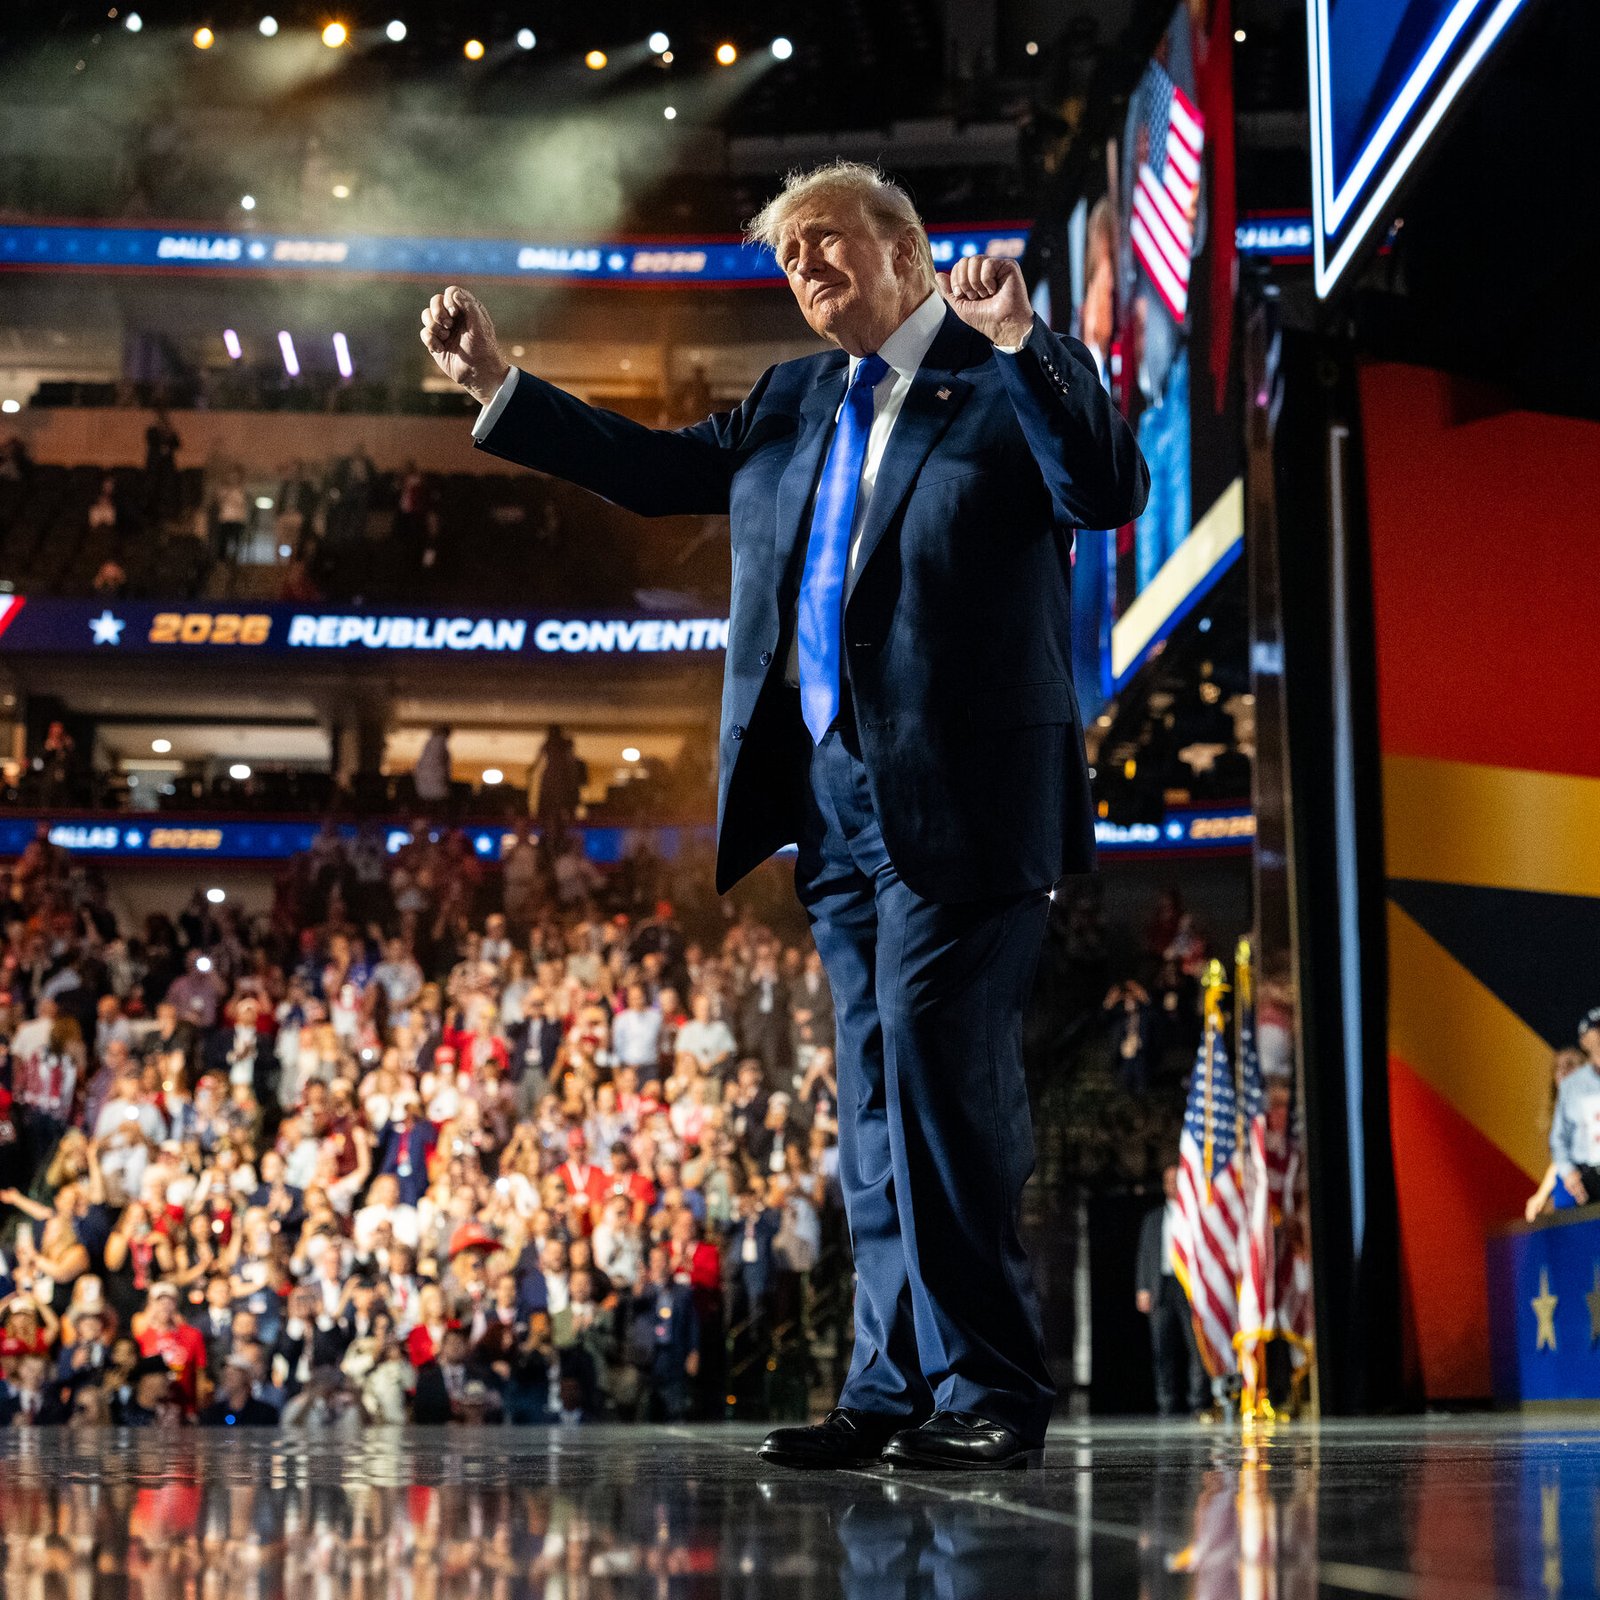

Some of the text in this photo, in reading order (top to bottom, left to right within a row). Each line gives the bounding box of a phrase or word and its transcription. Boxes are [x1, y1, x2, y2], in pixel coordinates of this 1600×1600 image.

[157, 237, 241, 260] DALLAS
[517, 248, 600, 271] DALLAS
[148, 612, 272, 644] 2026
[287, 614, 527, 649] REPUBLICAN
